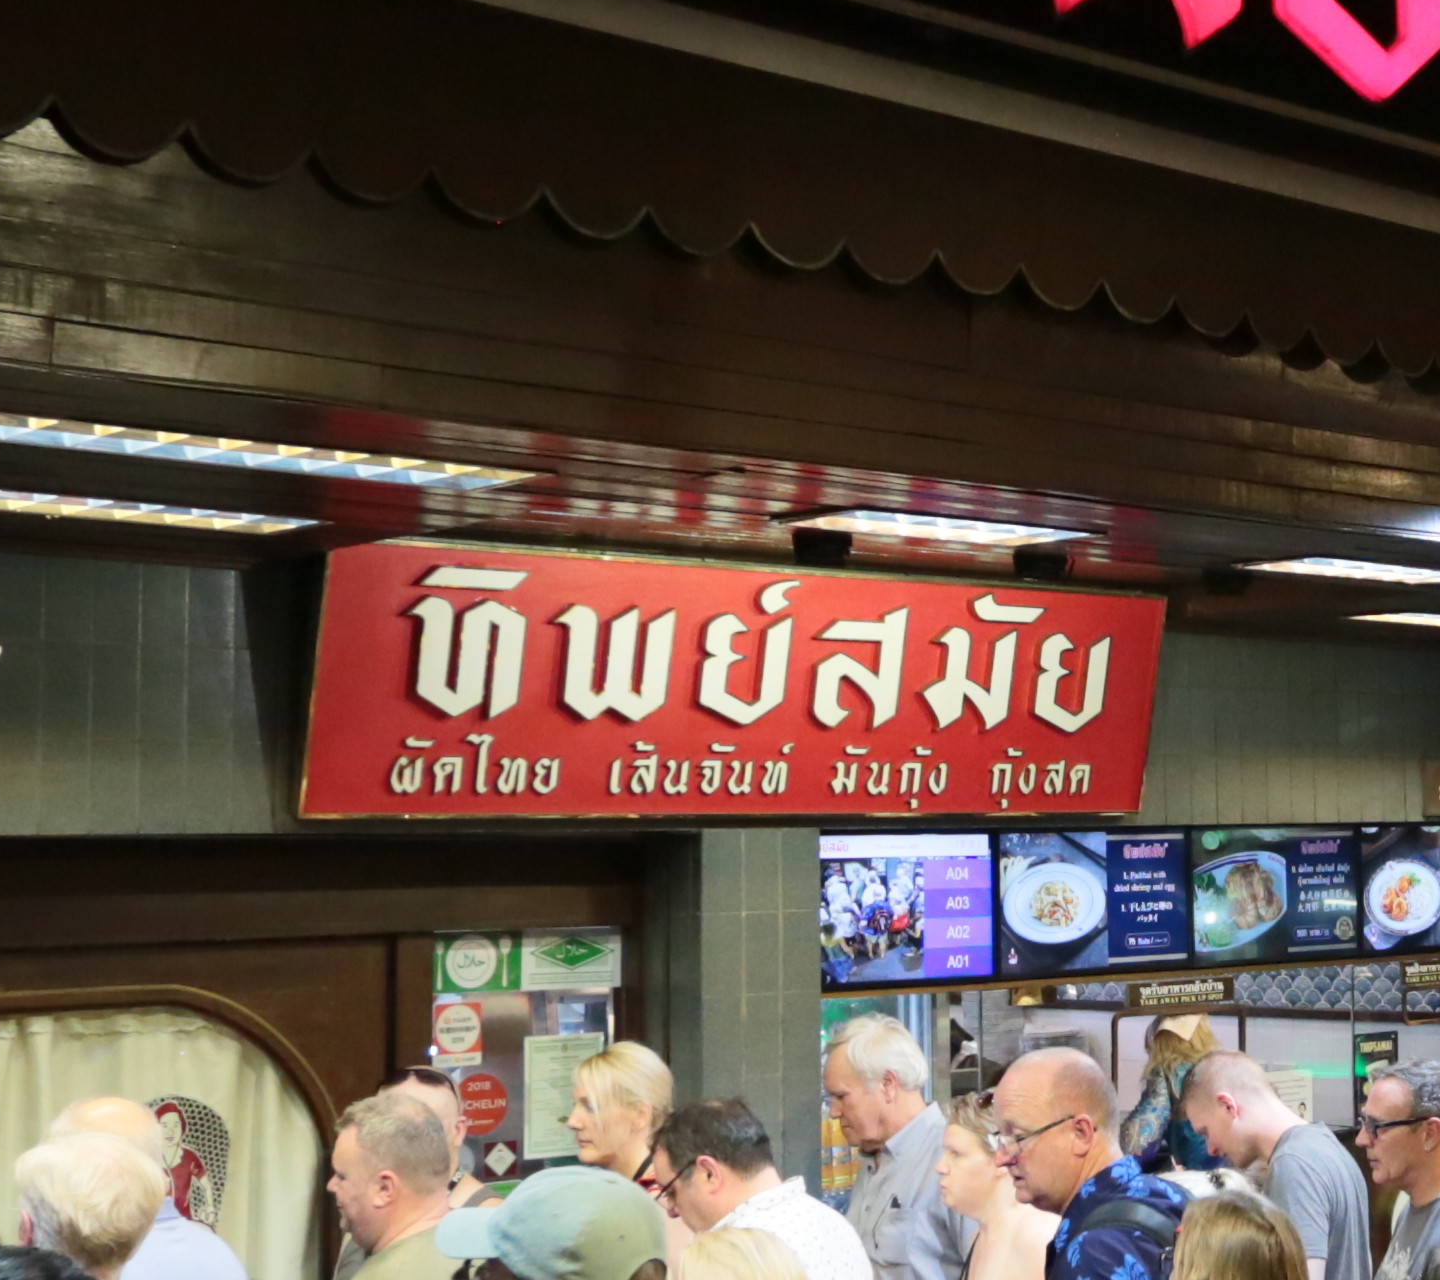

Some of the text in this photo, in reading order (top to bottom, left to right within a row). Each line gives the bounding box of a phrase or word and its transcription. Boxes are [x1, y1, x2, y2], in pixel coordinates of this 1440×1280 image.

[408, 565, 1112, 734] ทิพย์สมัย
[389, 733, 1092, 810] ผัดไทย เส้นจันท์ มันกุ้ง กุ้งสด
[945, 867, 969, 880] A04
[945, 896, 970, 910] A03
[946, 925, 970, 939] A02
[946, 955, 969, 968] A01
[1140, 998, 1158, 1006] TAKE
[1160, 996, 1180, 1005] AWAY
[1359, 1039, 1393, 1053] THIPSAMAI
[467, 1081, 492, 1092] 2018
[462, 1097, 507, 1111] CHELIN
